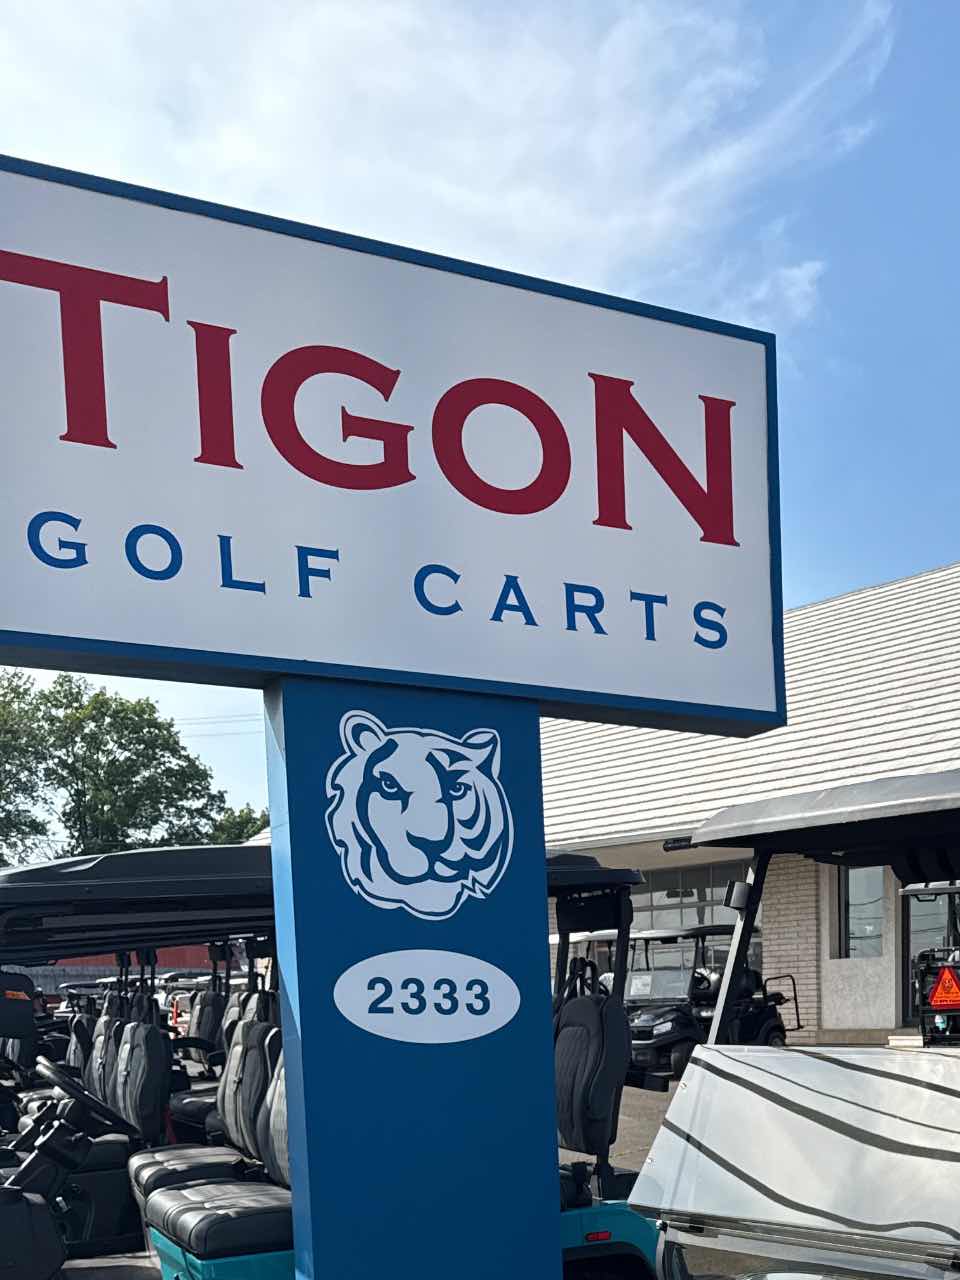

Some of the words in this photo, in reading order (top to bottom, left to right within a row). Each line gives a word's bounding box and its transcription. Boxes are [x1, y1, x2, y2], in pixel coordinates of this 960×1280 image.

[0, 249, 740, 548] TIGON
[26, 510, 340, 598] GOLF
[413, 563, 729, 650] CARTS
[366, 976, 491, 1016] 2333
